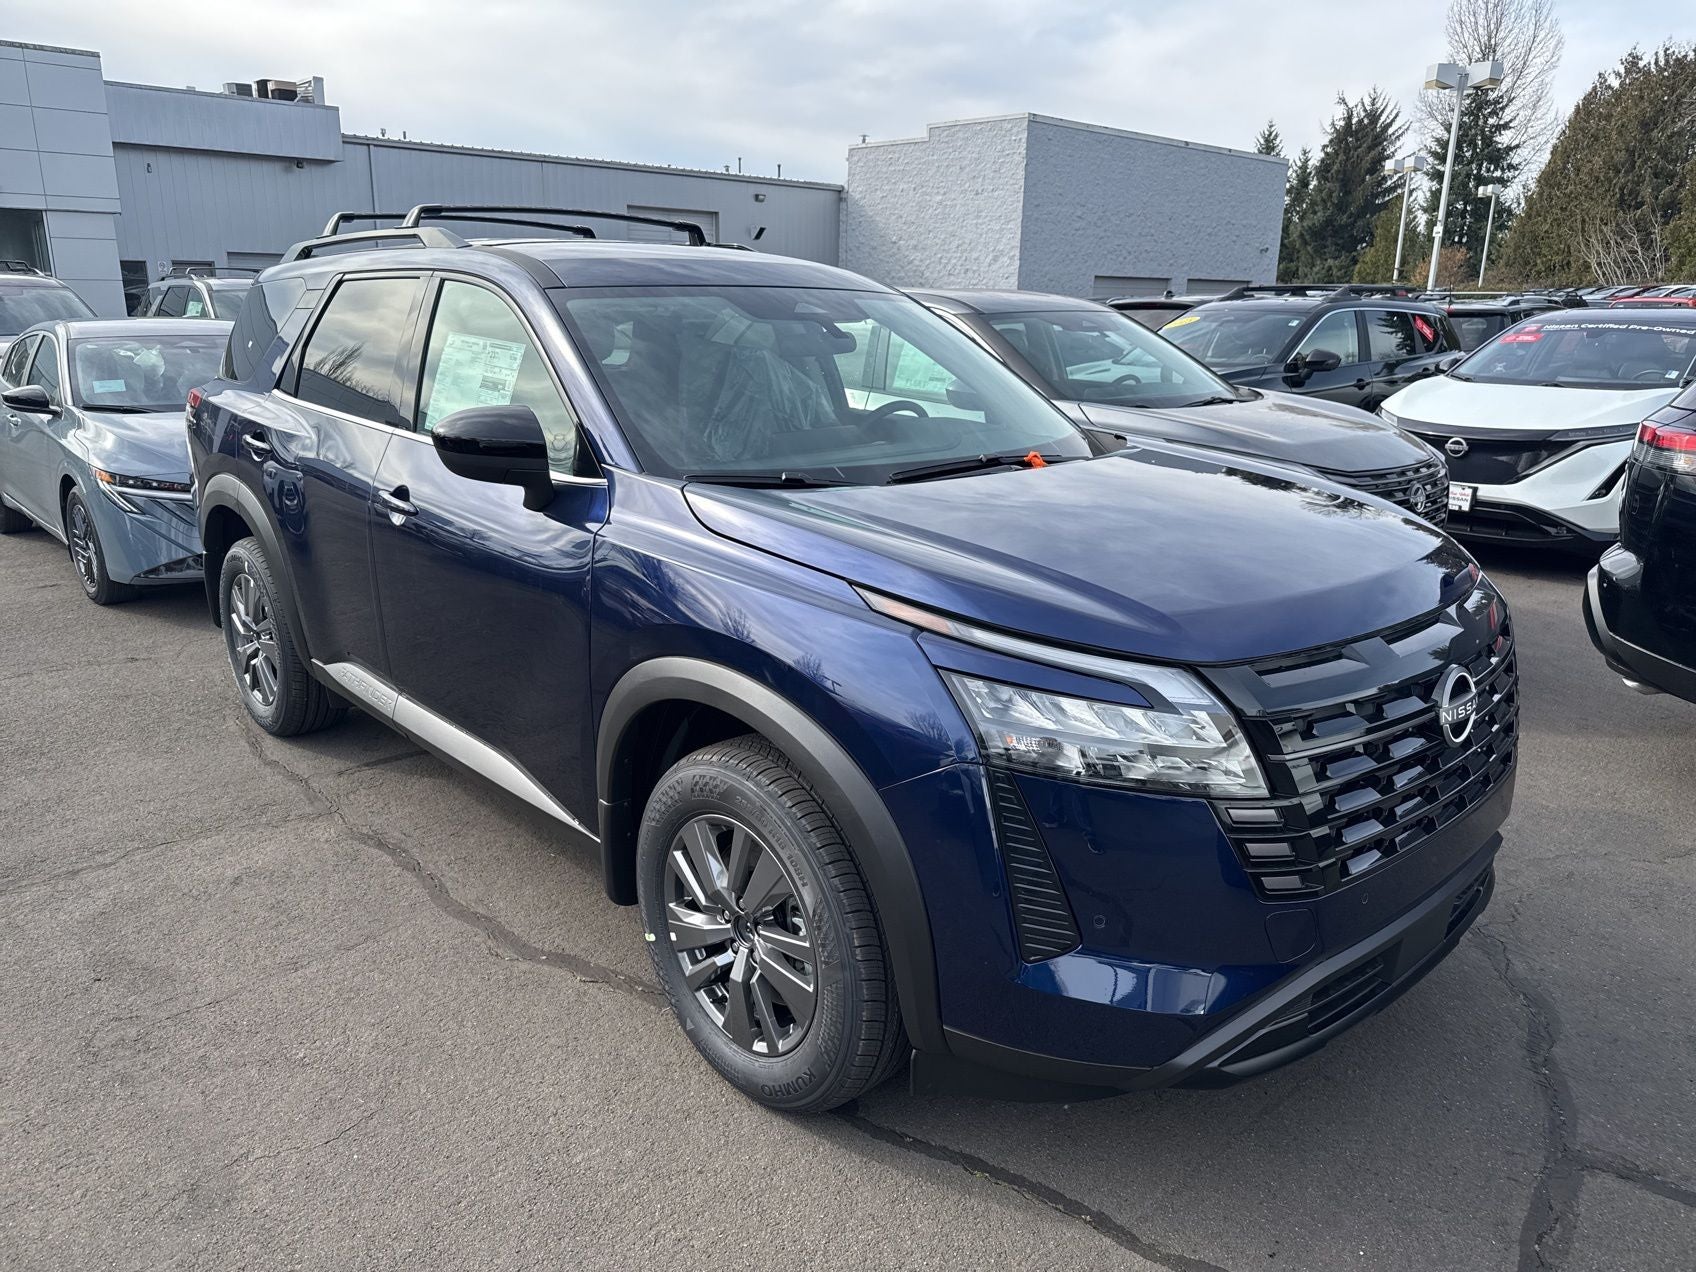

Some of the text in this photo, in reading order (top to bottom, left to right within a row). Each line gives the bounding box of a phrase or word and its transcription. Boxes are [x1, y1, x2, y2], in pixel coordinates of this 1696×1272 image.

[1628, 324, 1696, 335] Pre-Owned
[338, 667, 393, 711] PATHFINDER
[1442, 694, 1478, 723] NISSAN
[760, 1067, 817, 1097] KUMHO
